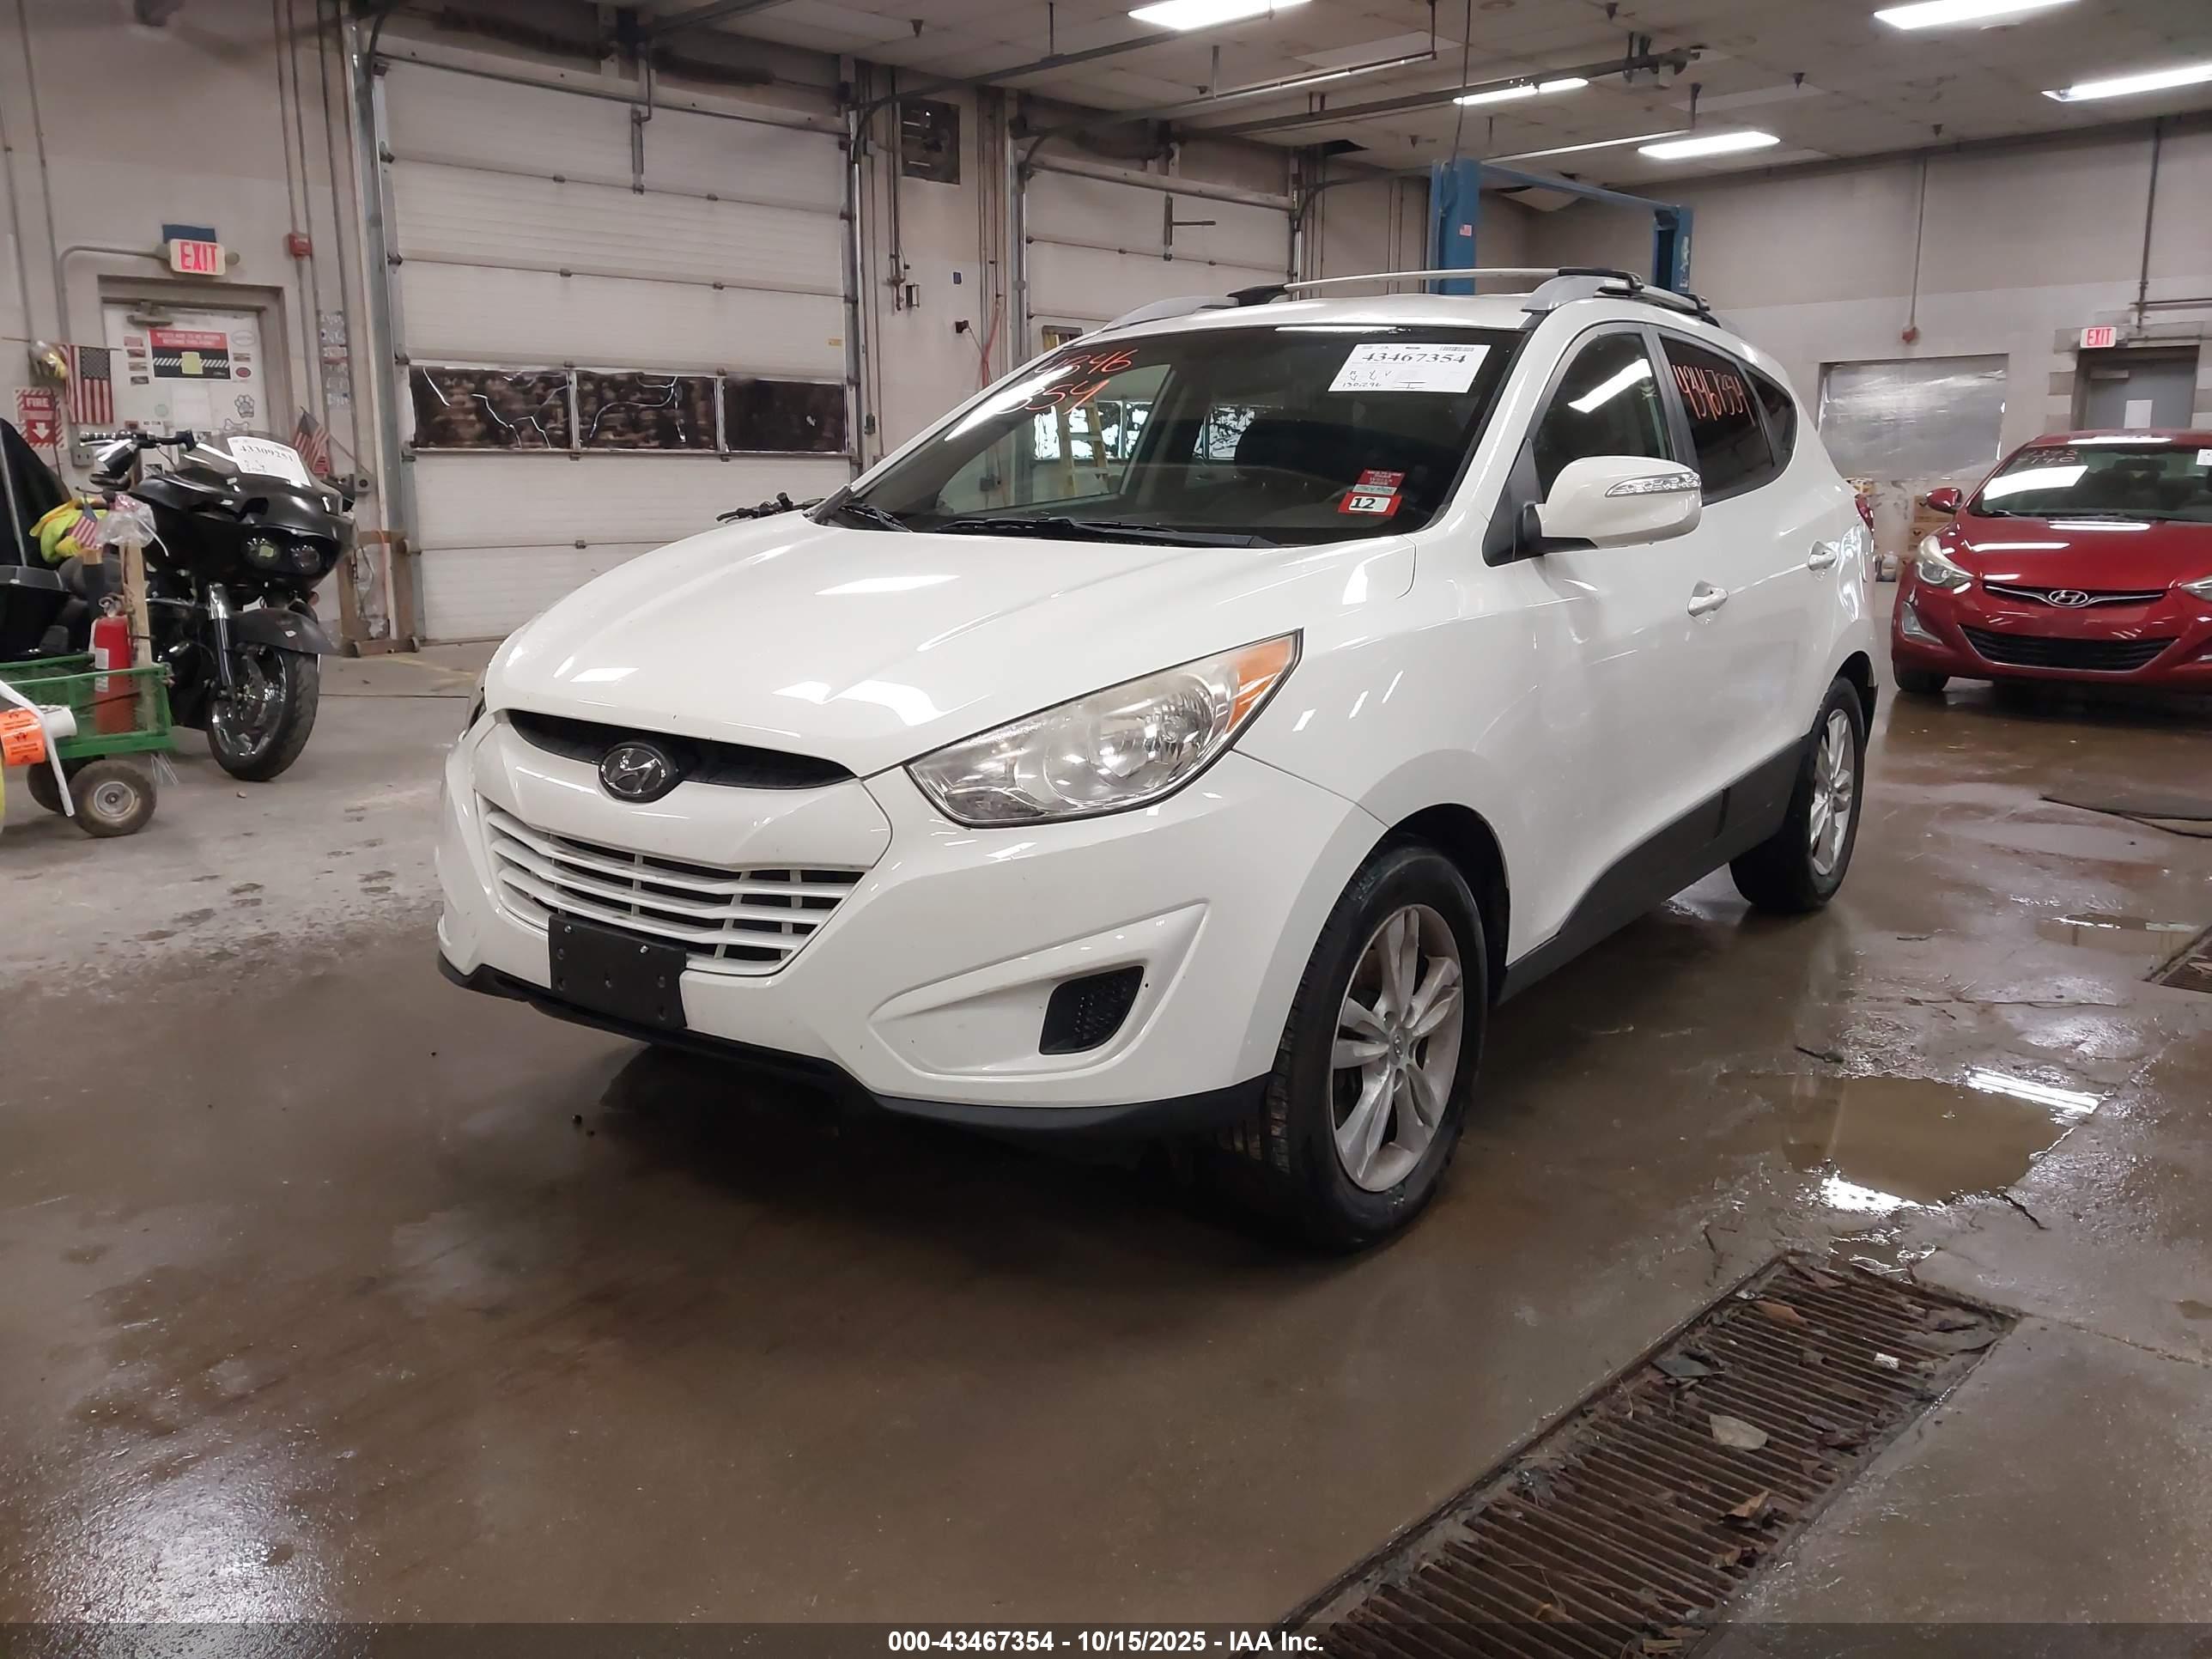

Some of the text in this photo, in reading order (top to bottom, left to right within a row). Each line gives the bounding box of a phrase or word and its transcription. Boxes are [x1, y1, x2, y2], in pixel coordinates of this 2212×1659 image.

[180, 241, 217, 272] EXIT
[2087, 328, 2112, 346] EXIT
[1362, 352, 1467, 363] 43467354
[26, 398, 50, 408] FIRE
[1350, 497, 1376, 509] 12
